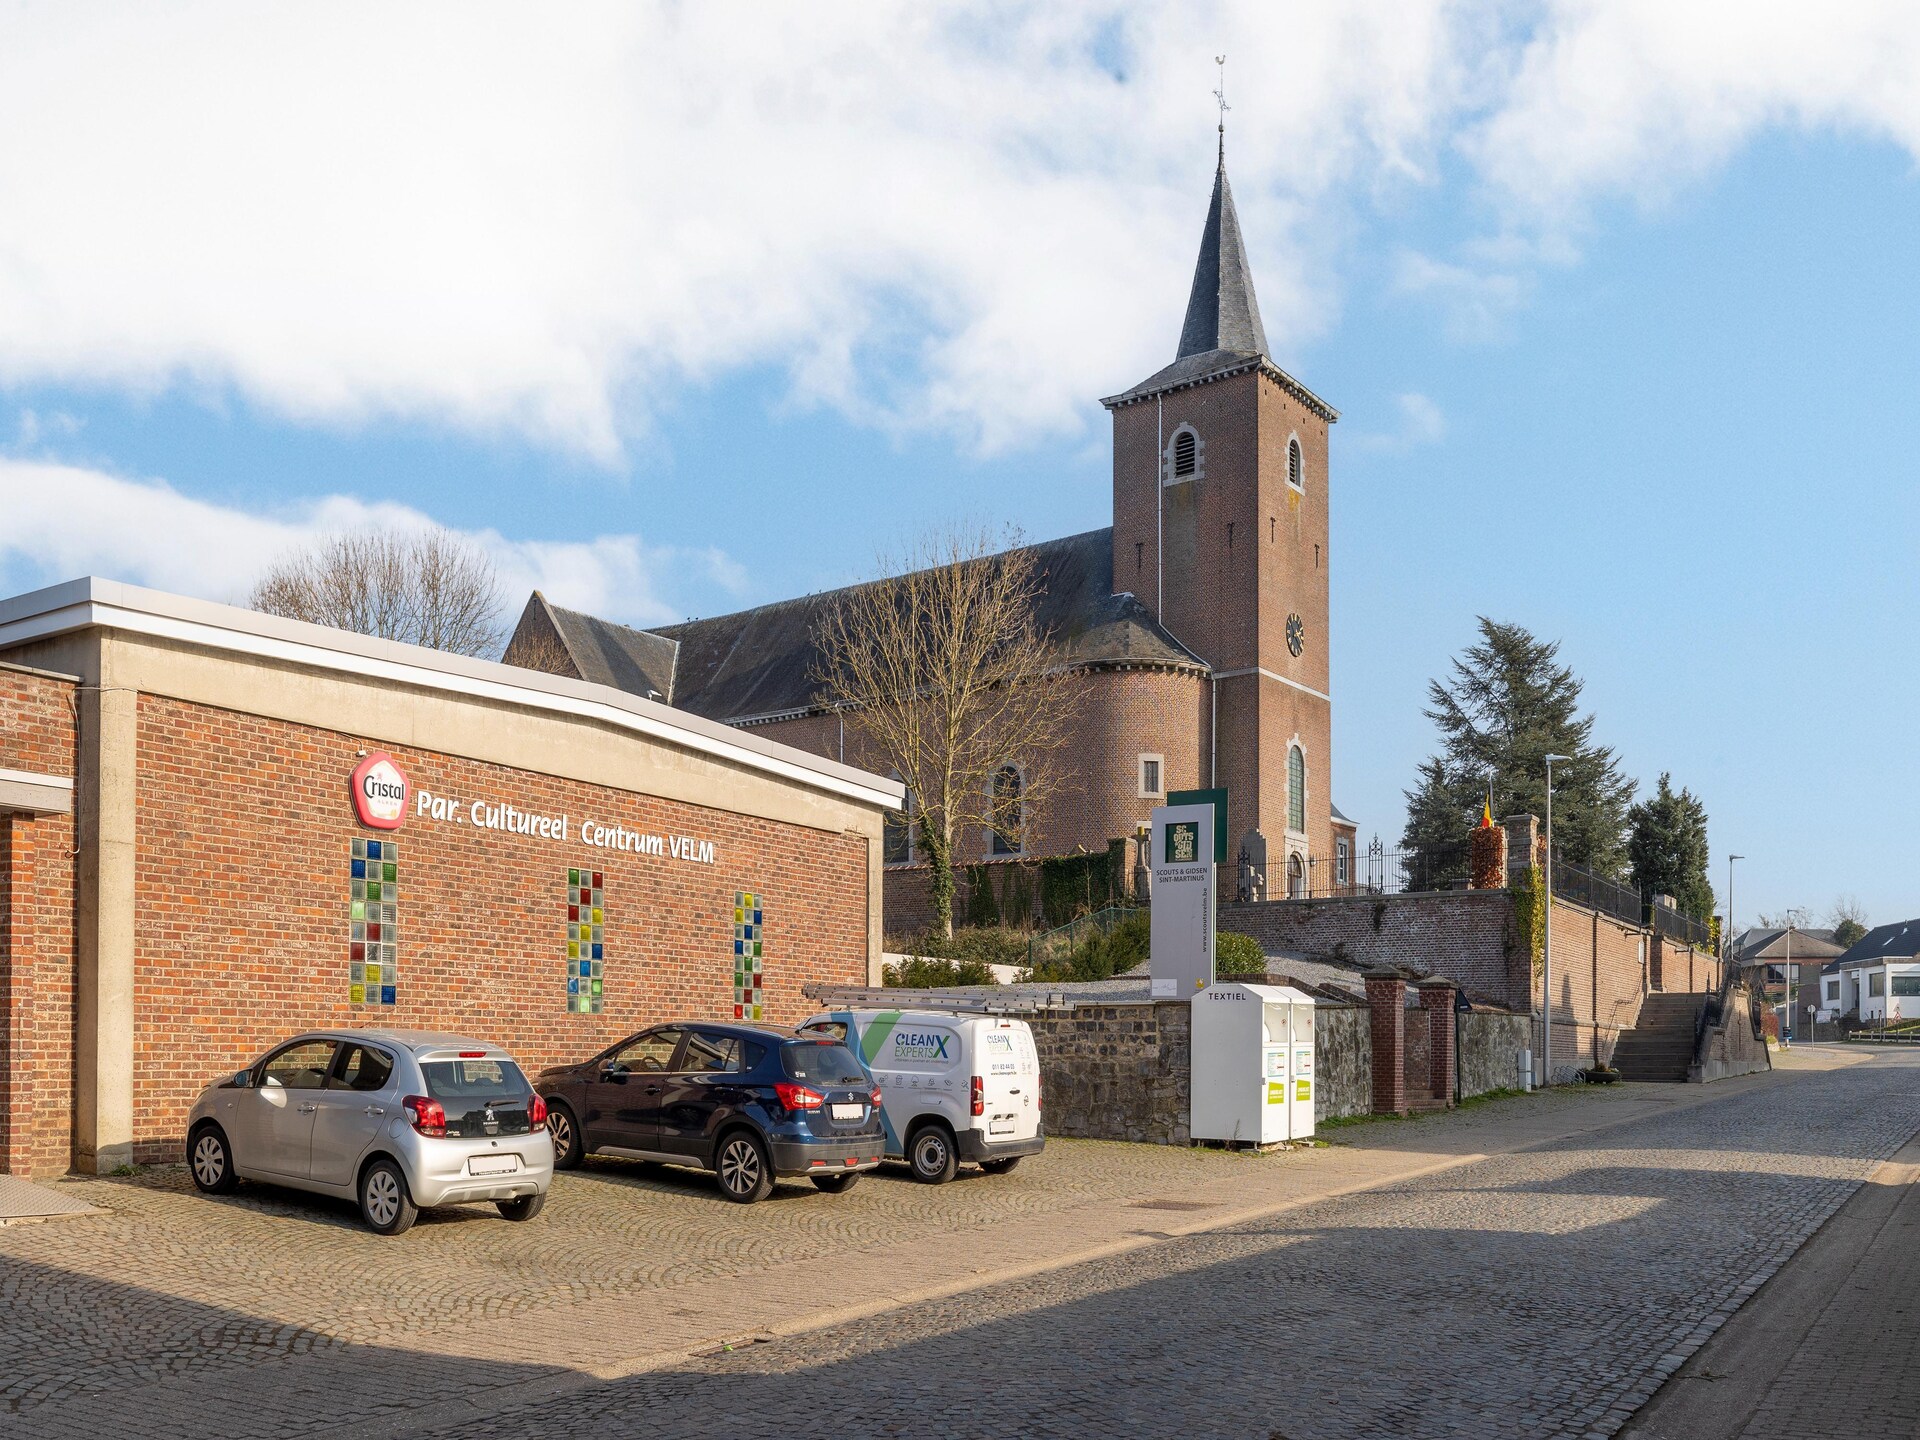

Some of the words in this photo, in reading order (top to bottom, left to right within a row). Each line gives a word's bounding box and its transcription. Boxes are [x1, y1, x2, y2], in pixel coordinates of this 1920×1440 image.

[363, 775, 405, 800] Cristal
[416, 790, 462, 823] Par.
[470, 801, 567, 840] Cultureel
[581, 821, 663, 855] Centrum
[669, 835, 714, 864] VELM
[1185, 867, 1208, 875] GIDSEN
[1159, 875, 1205, 883] SINT-MARTINUS
[1208, 993, 1247, 1001] TEXTIEL
[894, 1046, 934, 1059] EXPERTS
